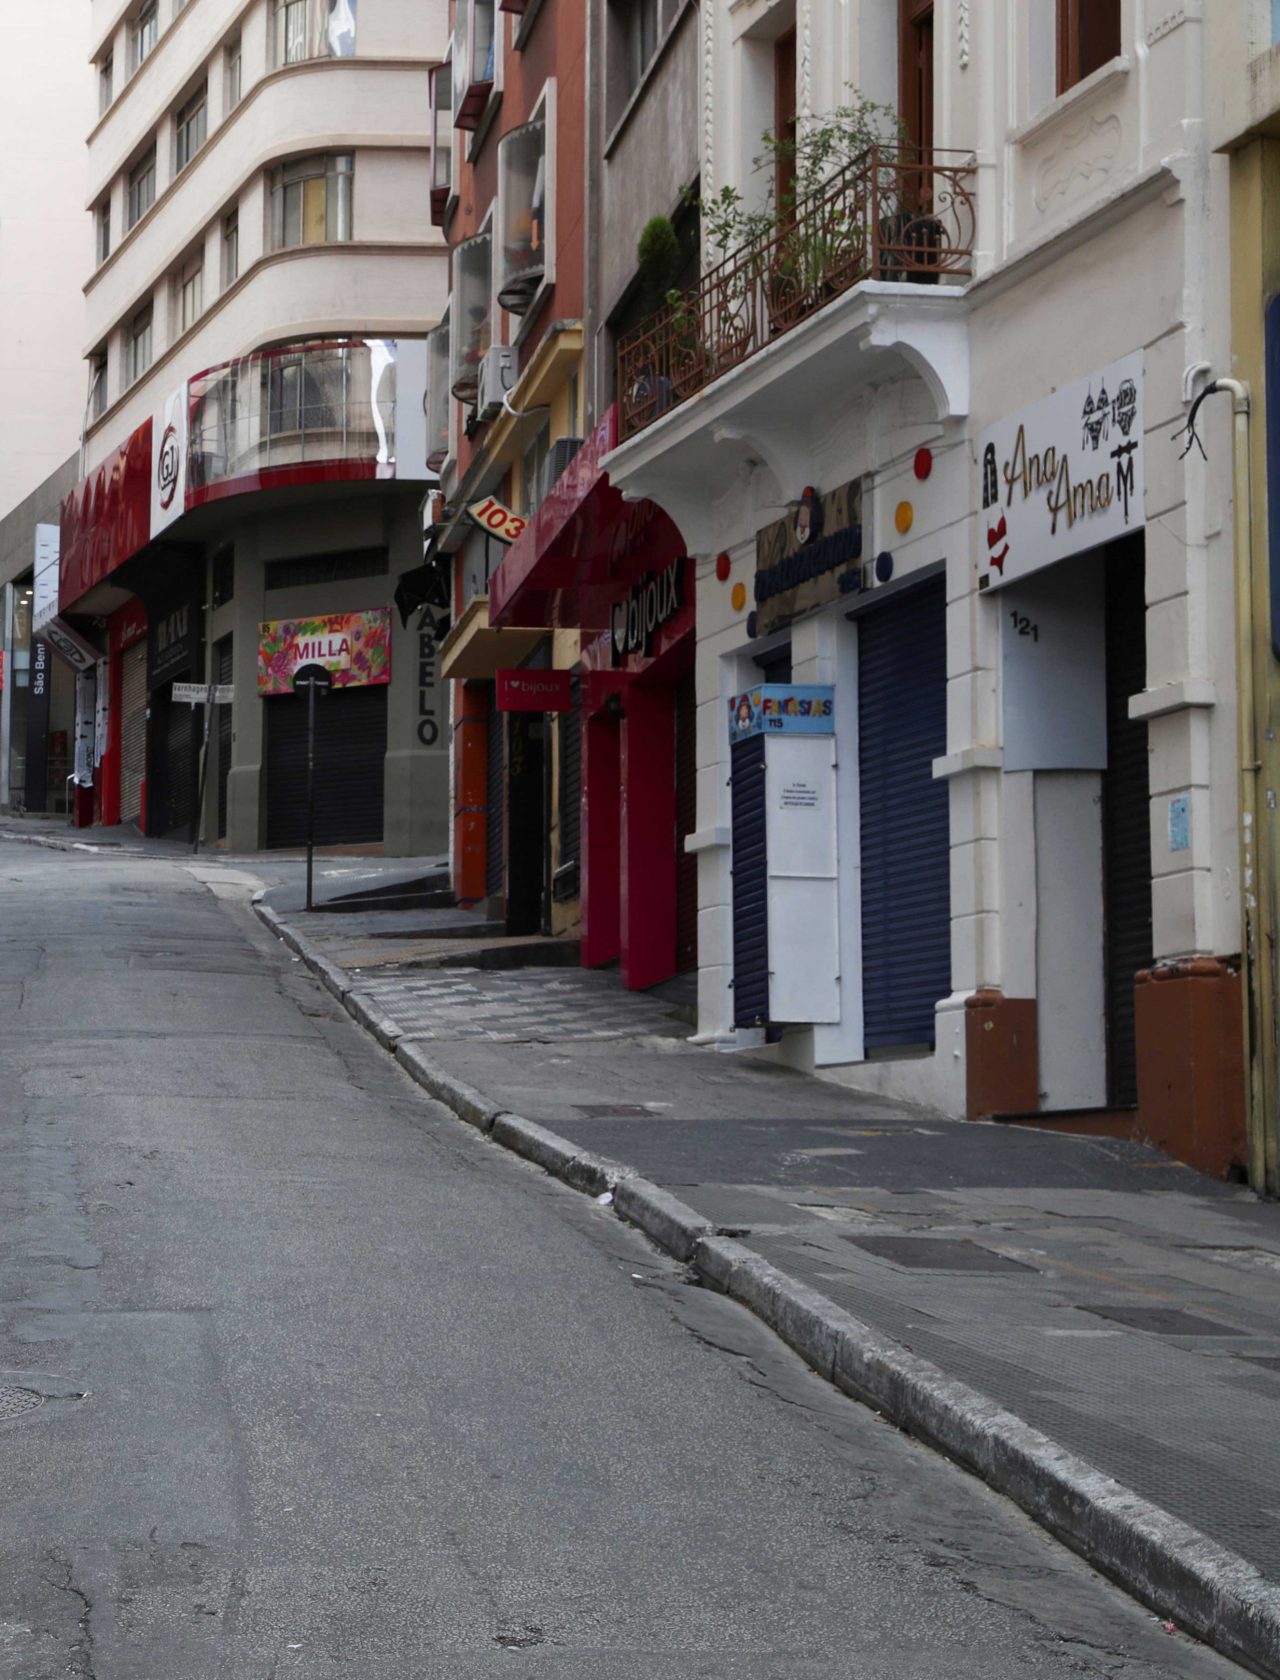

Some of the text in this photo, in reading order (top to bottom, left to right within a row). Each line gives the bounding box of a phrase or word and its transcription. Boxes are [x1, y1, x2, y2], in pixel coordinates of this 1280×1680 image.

[1003, 423, 1059, 508] Ana
[1047, 453, 1114, 536] Ama
[476, 498, 526, 540] 103
[627, 559, 679, 657] bijoux
[1010, 610, 1038, 643] 121
[34, 643, 45, 695] São Bent
[295, 637, 351, 660] MILLA
[417, 604, 439, 746] ABELO
[521, 680, 561, 695] bijoux
[762, 697, 833, 717] FANTASIAS
[769, 718, 784, 728] 115
